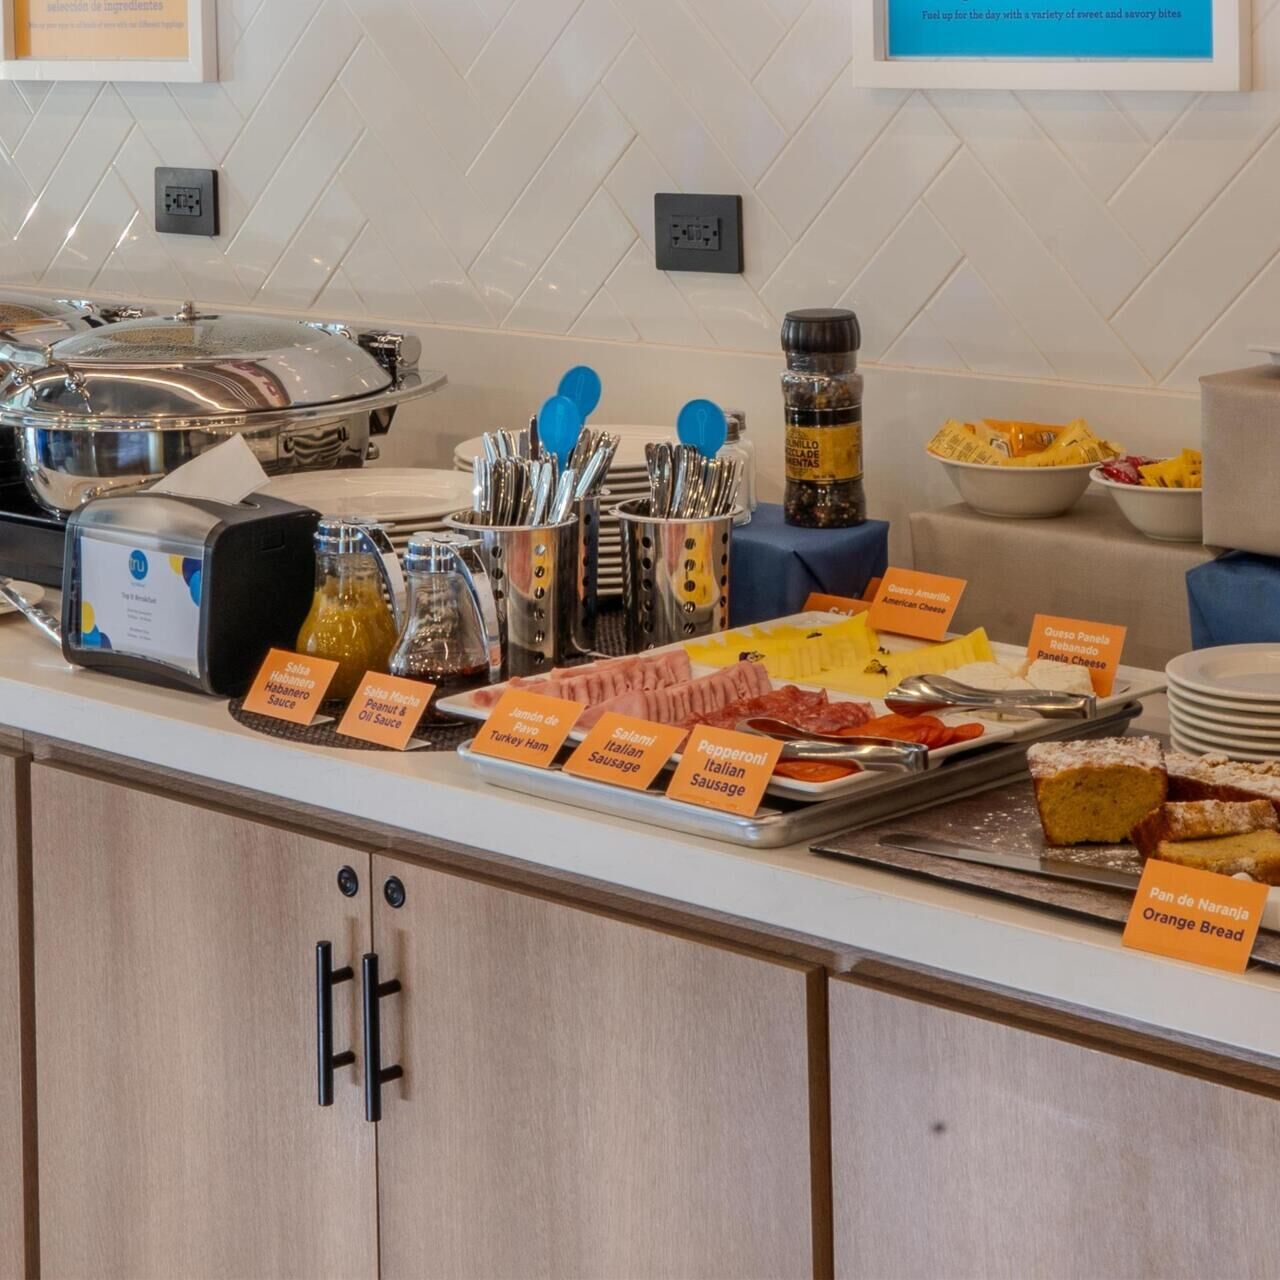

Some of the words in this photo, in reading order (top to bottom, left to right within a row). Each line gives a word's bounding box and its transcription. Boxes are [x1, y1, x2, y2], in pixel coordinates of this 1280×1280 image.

[922, 10, 940, 20] Fuel
[955, 9, 967, 20] for
[969, 9, 984, 20] the
[985, 9, 1000, 22] day
[1003, 8, 1022, 19] with
[1031, 8, 1063, 20] variety
[1066, 8, 1075, 18] of
[1077, 9, 1102, 18] sweet
[1105, 8, 1122, 18] and
[1124, 10, 1156, 20] savory
[1158, 8, 1182, 18] bites
[807, 450, 819, 459] DE
[887, 583, 914, 598] Queso
[914, 586, 951, 603] Amarillo
[882, 596, 918, 610] American
[918, 600, 947, 615] Cheese
[1044, 627, 1075, 640] Queso
[1077, 632, 1110, 646] Panela
[1050, 640, 1099, 656] Rebanado
[284, 662, 311, 676] Salsa
[1037, 650, 1069, 664] Panela
[1072, 655, 1107, 670] Cheese
[270, 672, 316, 689] Habanera
[264, 682, 310, 701] Habanero
[363, 685, 389, 700] Salsa
[390, 691, 421, 707] Macha
[267, 694, 297, 710] Sauce
[364, 698, 398, 715] Peanut
[398, 705, 407, 717] &
[358, 710, 373, 724] Oil
[373, 714, 402, 729] Sauce
[509, 707, 544, 723] Jamón
[544, 714, 560, 727] de
[513, 722, 540, 737] Pavo
[612, 728, 657, 747] Salami
[489, 730, 524, 748] Turkey
[524, 738, 549, 753] Ham
[603, 740, 644, 759] Italian
[588, 751, 641, 773] Sausage
[697, 740, 768, 766] Pepperoni
[704, 758, 746, 779] Italian
[690, 773, 745, 797] Sausage
[1149, 887, 1174, 903] Pan
[1177, 893, 1195, 907] de
[1198, 898, 1249, 921] Naranja
[1143, 907, 1196, 931] Orange
[1200, 920, 1245, 942] Bread
